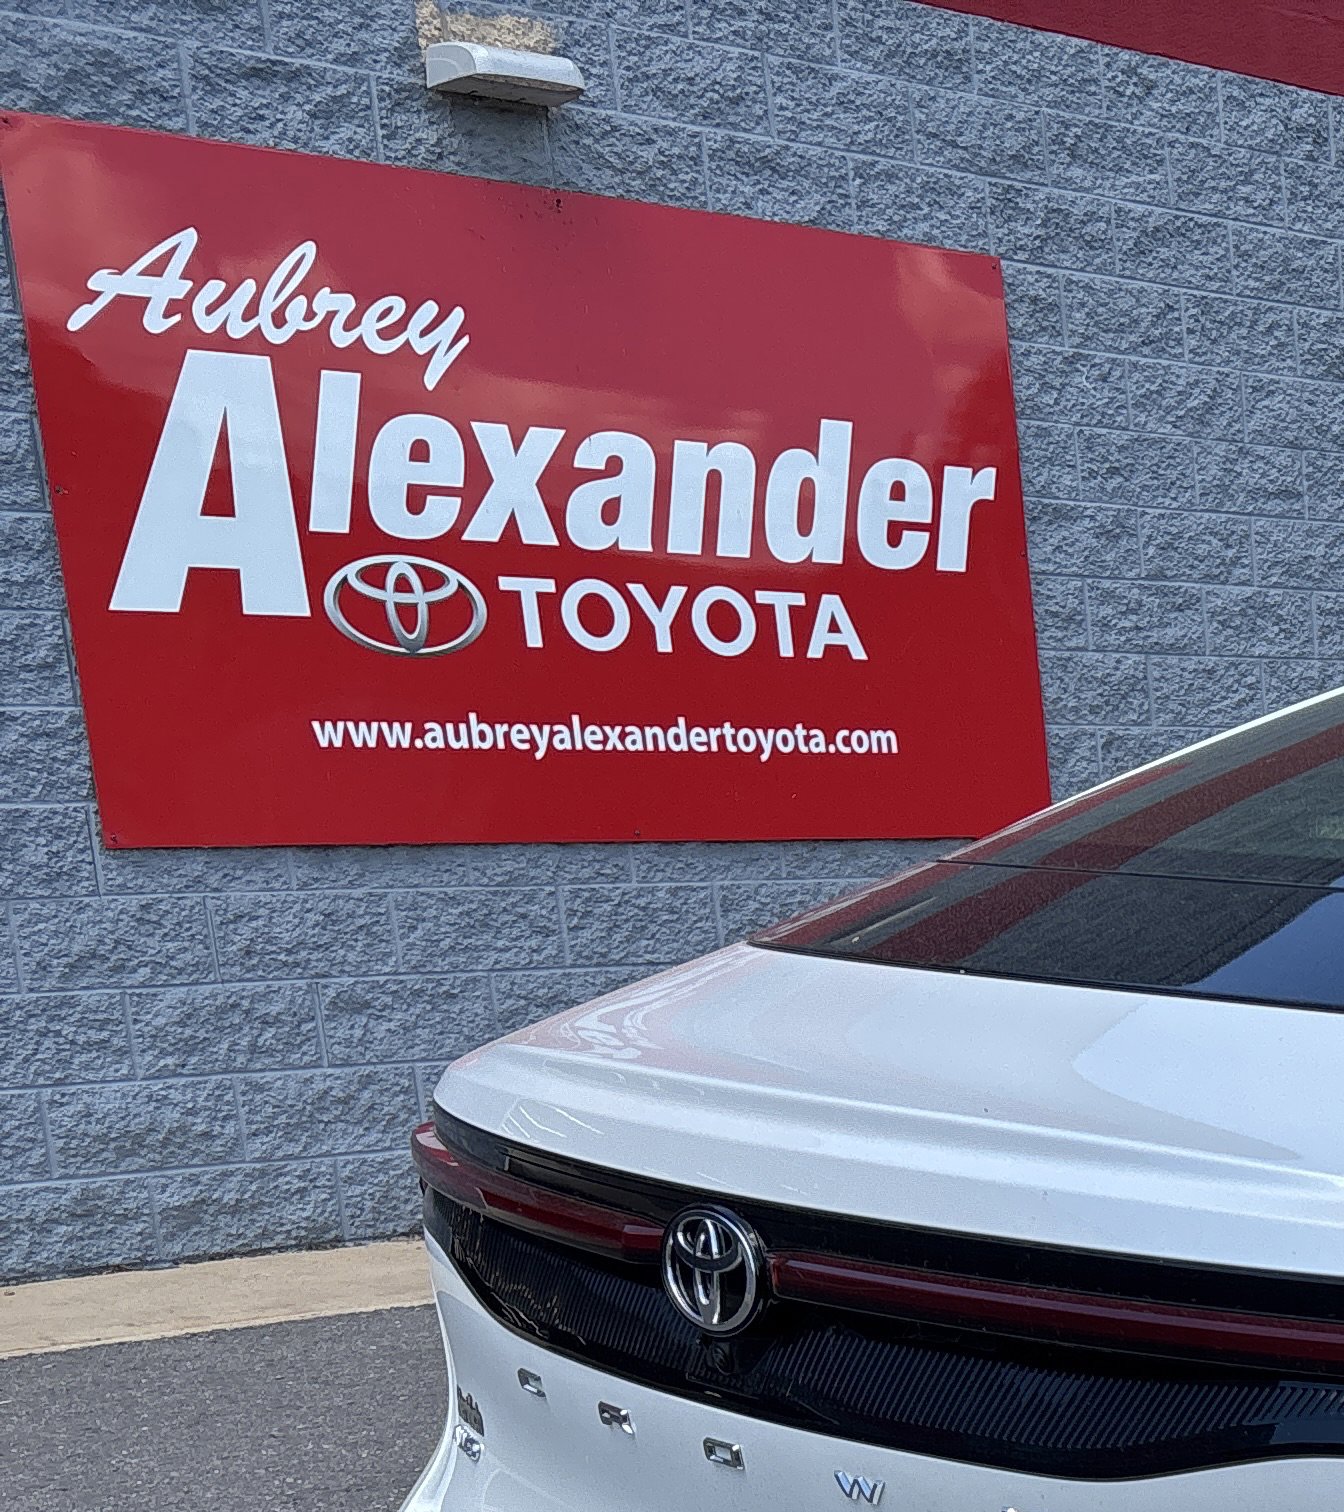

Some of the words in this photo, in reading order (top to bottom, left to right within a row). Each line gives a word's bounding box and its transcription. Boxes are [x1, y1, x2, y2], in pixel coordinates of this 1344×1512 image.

[66, 226, 471, 391] Aubrey
[107, 348, 997, 618] Alexander
[497, 574, 868, 661] TOYOTA
[310, 714, 899, 762] www.aubreyalexandertoyota.com
